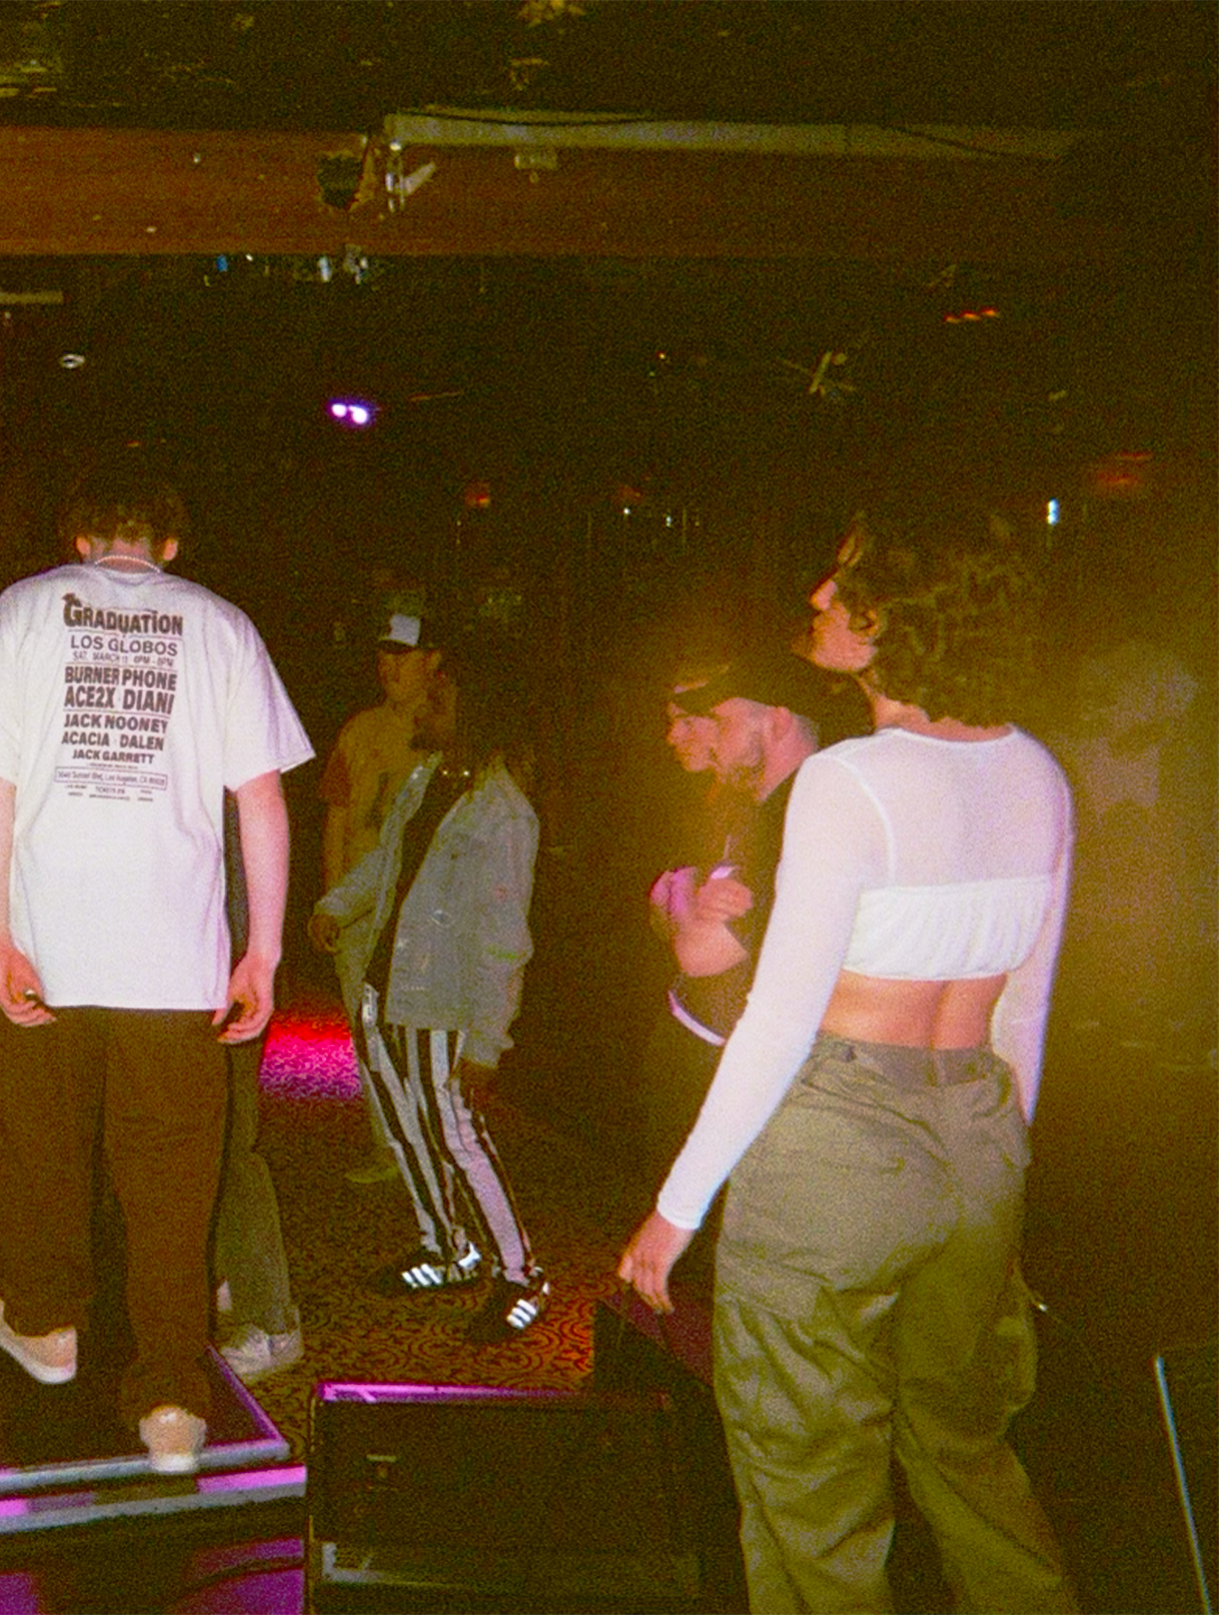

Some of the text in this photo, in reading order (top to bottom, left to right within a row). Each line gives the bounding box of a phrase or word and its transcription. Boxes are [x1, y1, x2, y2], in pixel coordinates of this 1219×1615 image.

[63, 597, 183, 636] GRADUATION
[71, 635, 178, 656] LOS GLOBOS
[65, 666, 177, 691] BURNER PHONE
[64, 686, 175, 715] ACE2X DIANI
[64, 714, 168, 734] JACK NOONEY
[61, 731, 164, 751] ACACIA DALEN
[72, 749, 155, 764] JACK GARRETT
